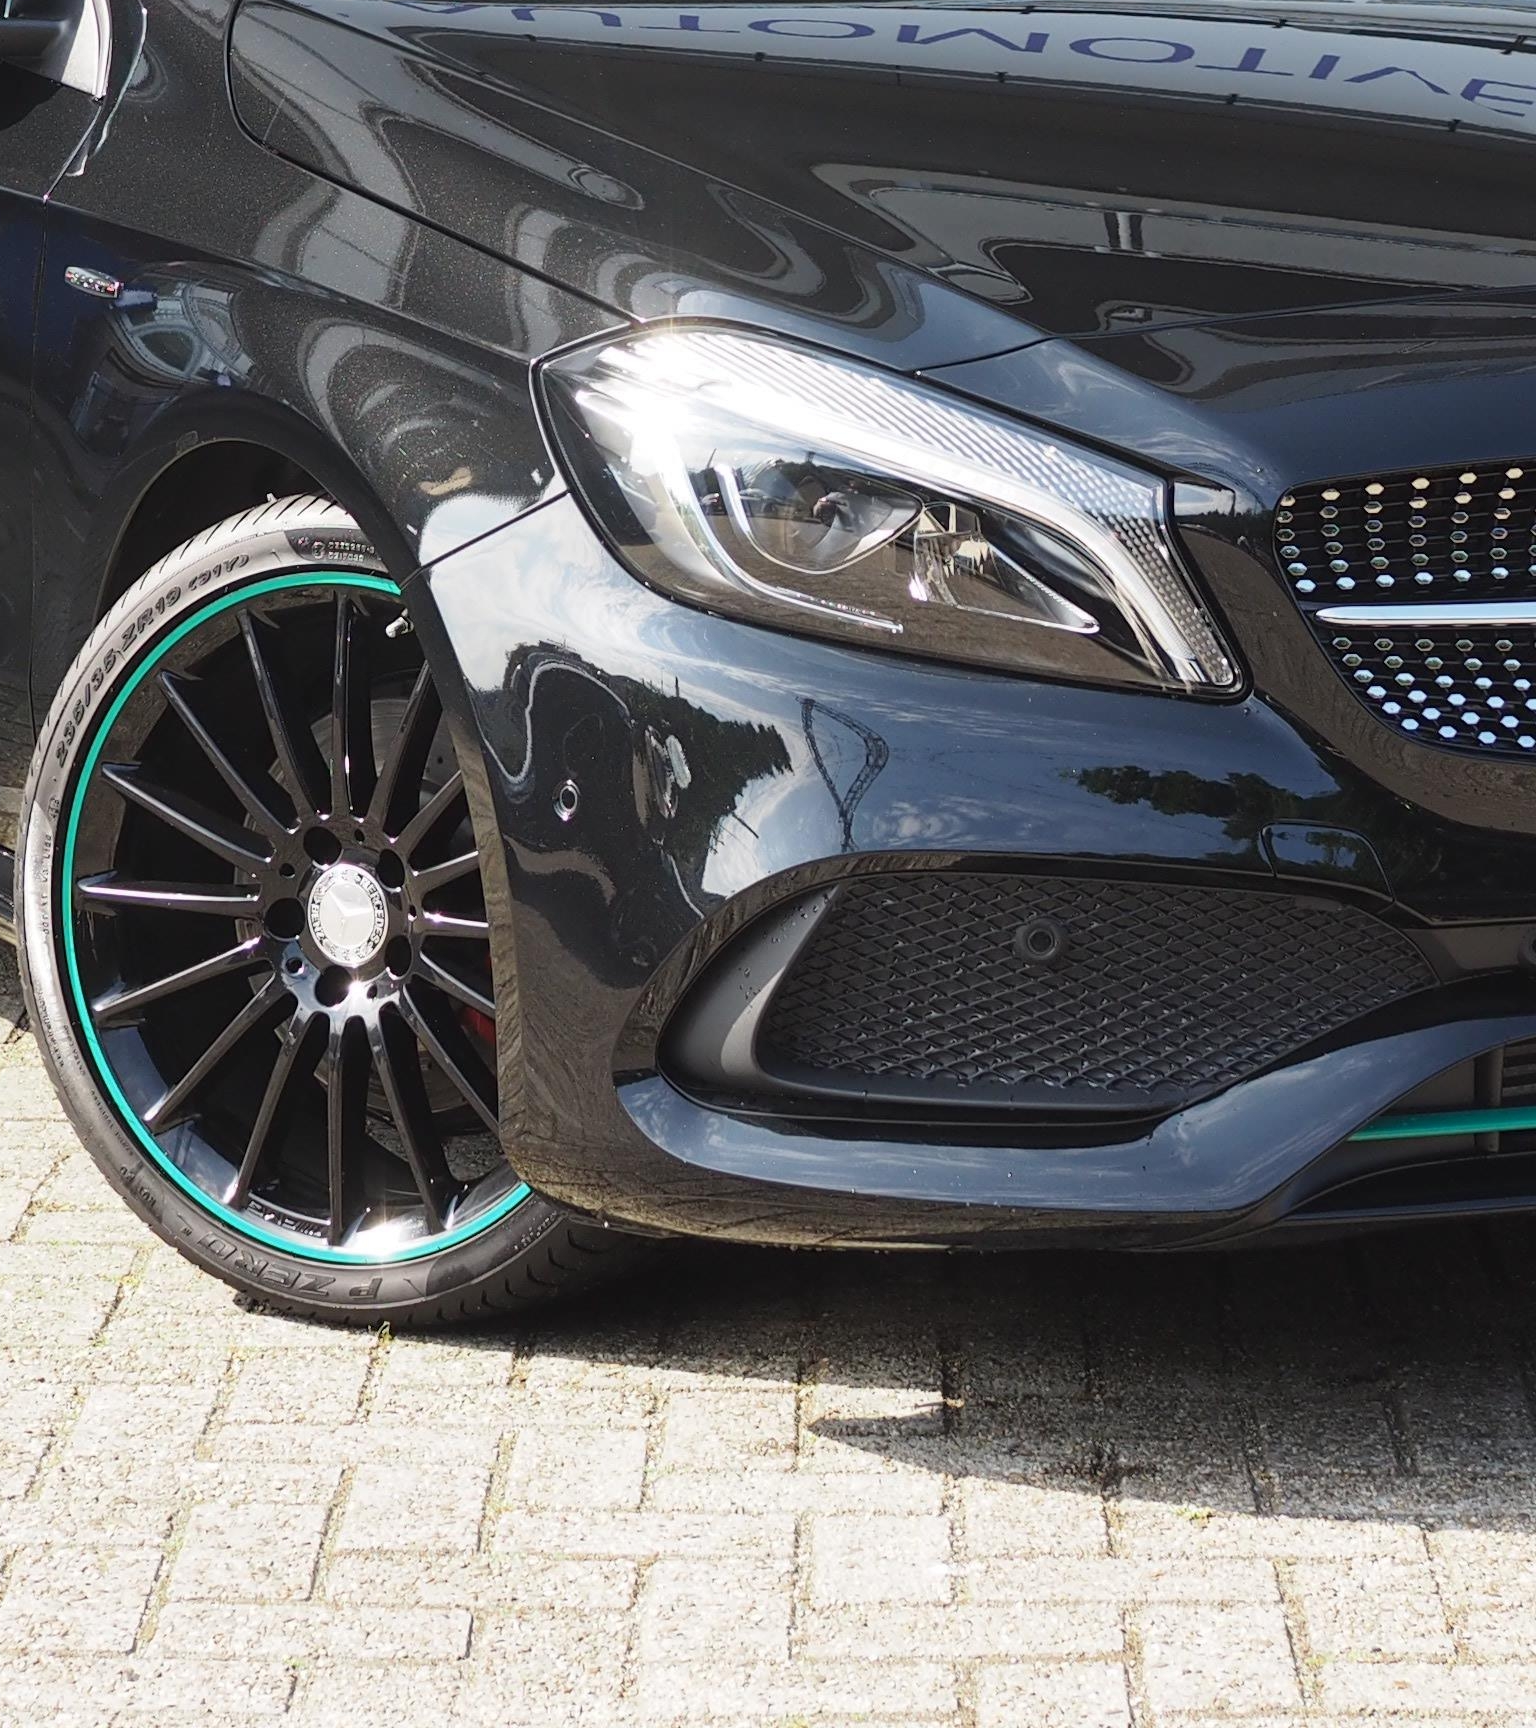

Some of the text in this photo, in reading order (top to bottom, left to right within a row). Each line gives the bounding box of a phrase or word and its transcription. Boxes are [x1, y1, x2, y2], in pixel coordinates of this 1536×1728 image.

[120, 585, 182, 653] ZR19
[196, 1230, 383, 1300] P ZERO
